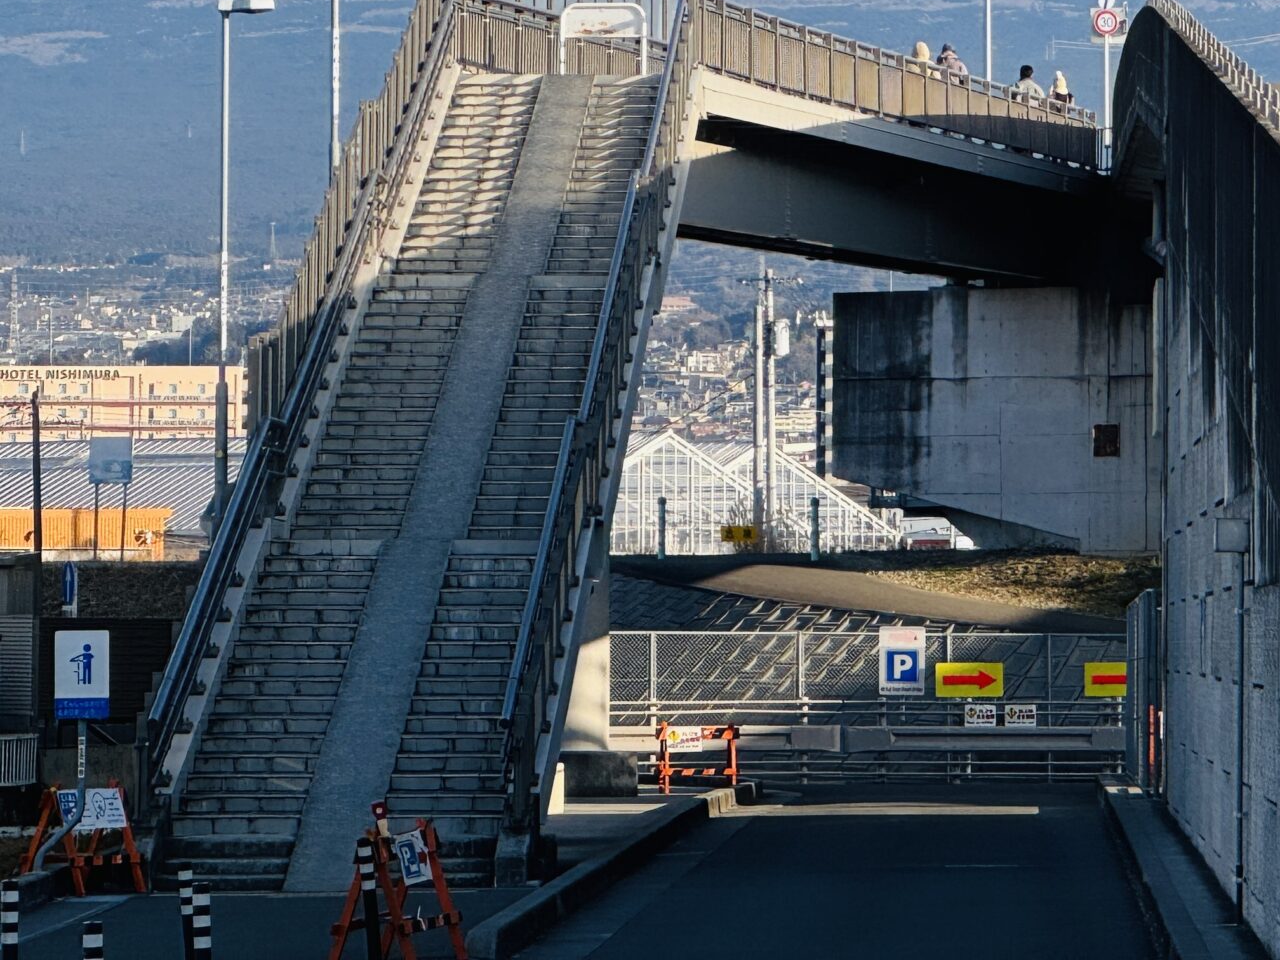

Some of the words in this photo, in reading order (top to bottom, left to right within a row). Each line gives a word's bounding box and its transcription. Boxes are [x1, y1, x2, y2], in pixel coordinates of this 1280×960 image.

[1100, 16, 1113, 28] 30
[0, 369, 42, 379] HOTEL
[45, 369, 120, 380] NISHIMURA
[893, 654, 913, 680] P
